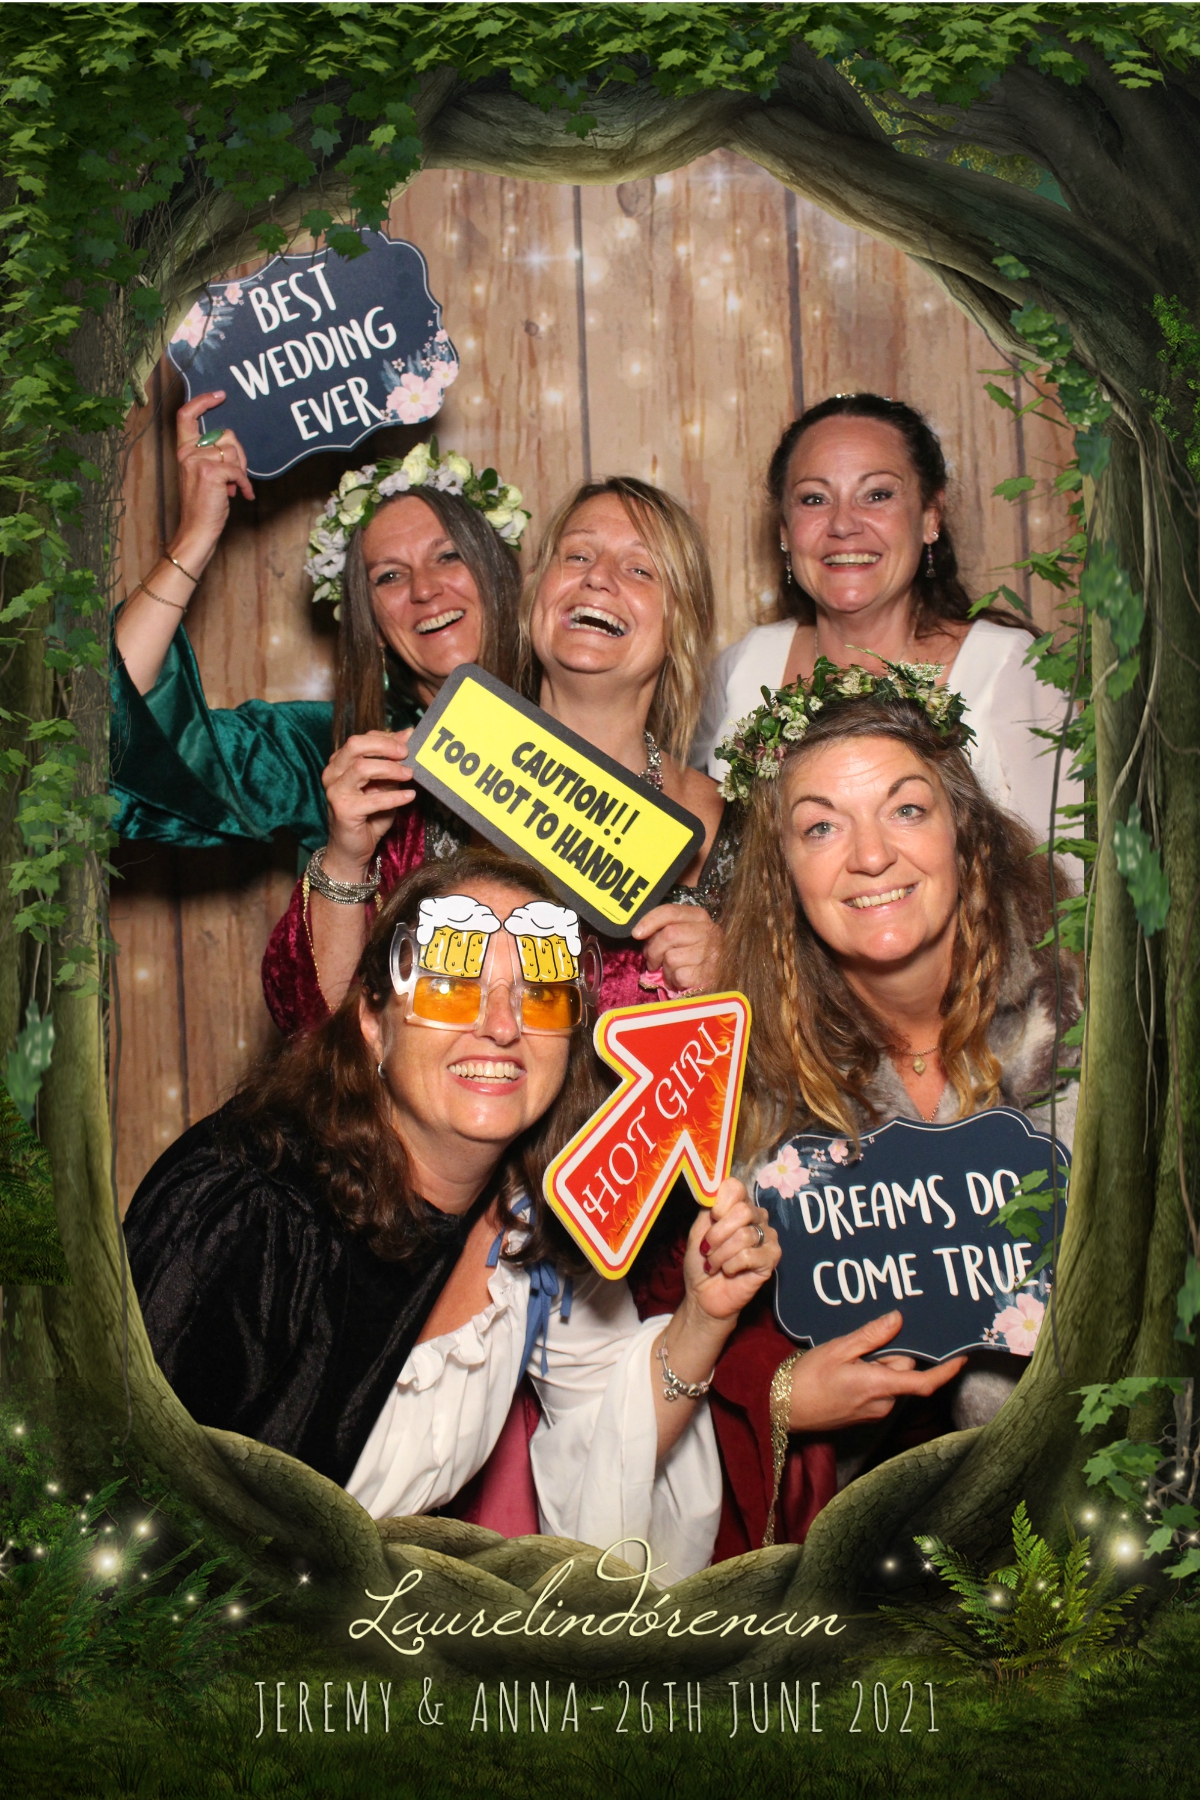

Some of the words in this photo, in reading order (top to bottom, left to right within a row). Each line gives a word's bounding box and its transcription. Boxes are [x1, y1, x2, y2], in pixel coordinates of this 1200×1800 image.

[249, 262, 337, 333] BEST
[229, 306, 397, 401] WEDDING
[290, 376, 384, 441] EVER
[431, 726, 481, 777] TOO
[474, 768, 532, 815] HOT
[524, 799, 559, 840] TO
[551, 823, 650, 914] HANDLE
[511, 741, 641, 845] CAUTION!!
[581, 1106, 657, 1223] HOT
[654, 1021, 731, 1121] GIRL
[798, 1174, 956, 1241] DREAMS
[812, 1252, 923, 1306] COME
[932, 1242, 1039, 1301] TRUE
